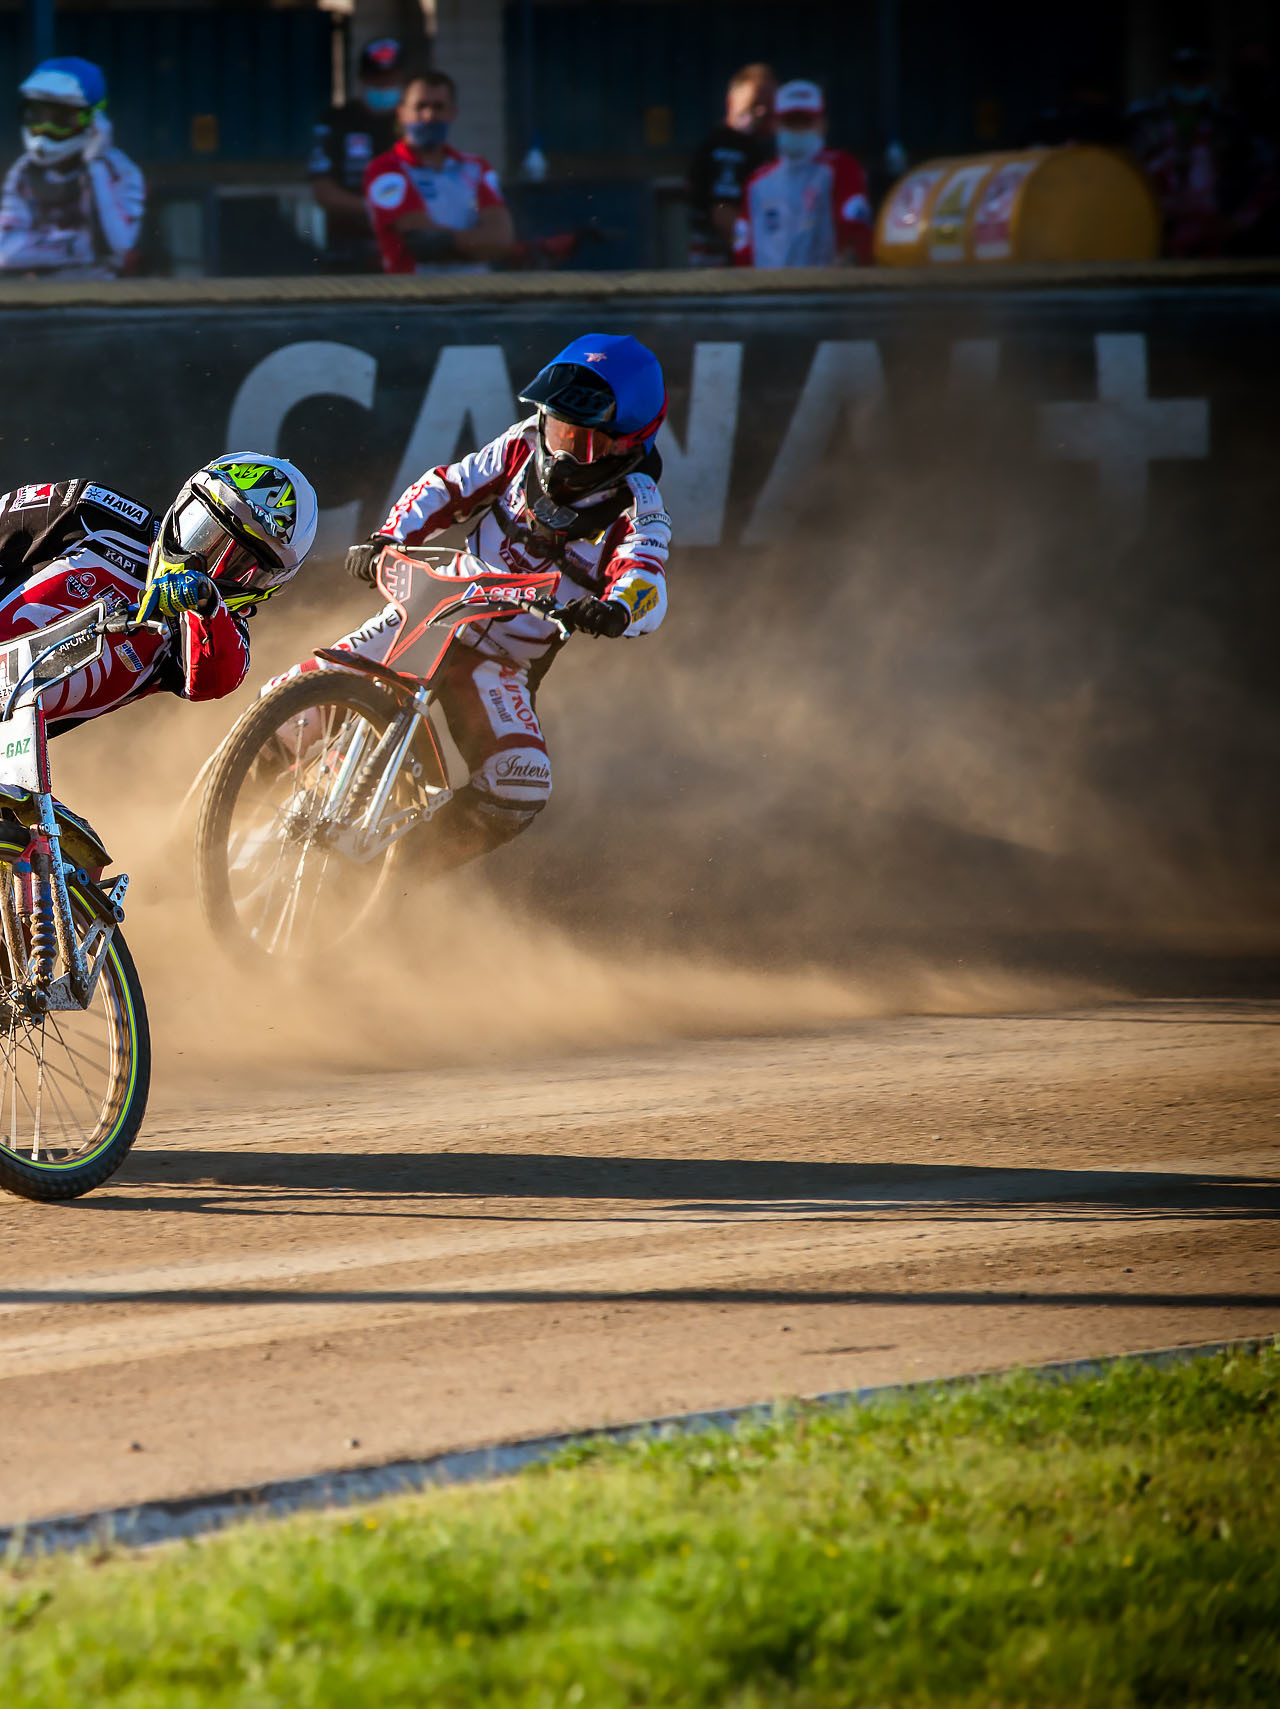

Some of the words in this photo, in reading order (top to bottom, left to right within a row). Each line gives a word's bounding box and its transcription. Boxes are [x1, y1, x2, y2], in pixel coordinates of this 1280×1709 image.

[102, 493, 144, 522] HAWA
[105, 549, 137, 575] KAPI
[66, 574, 90, 600] START
